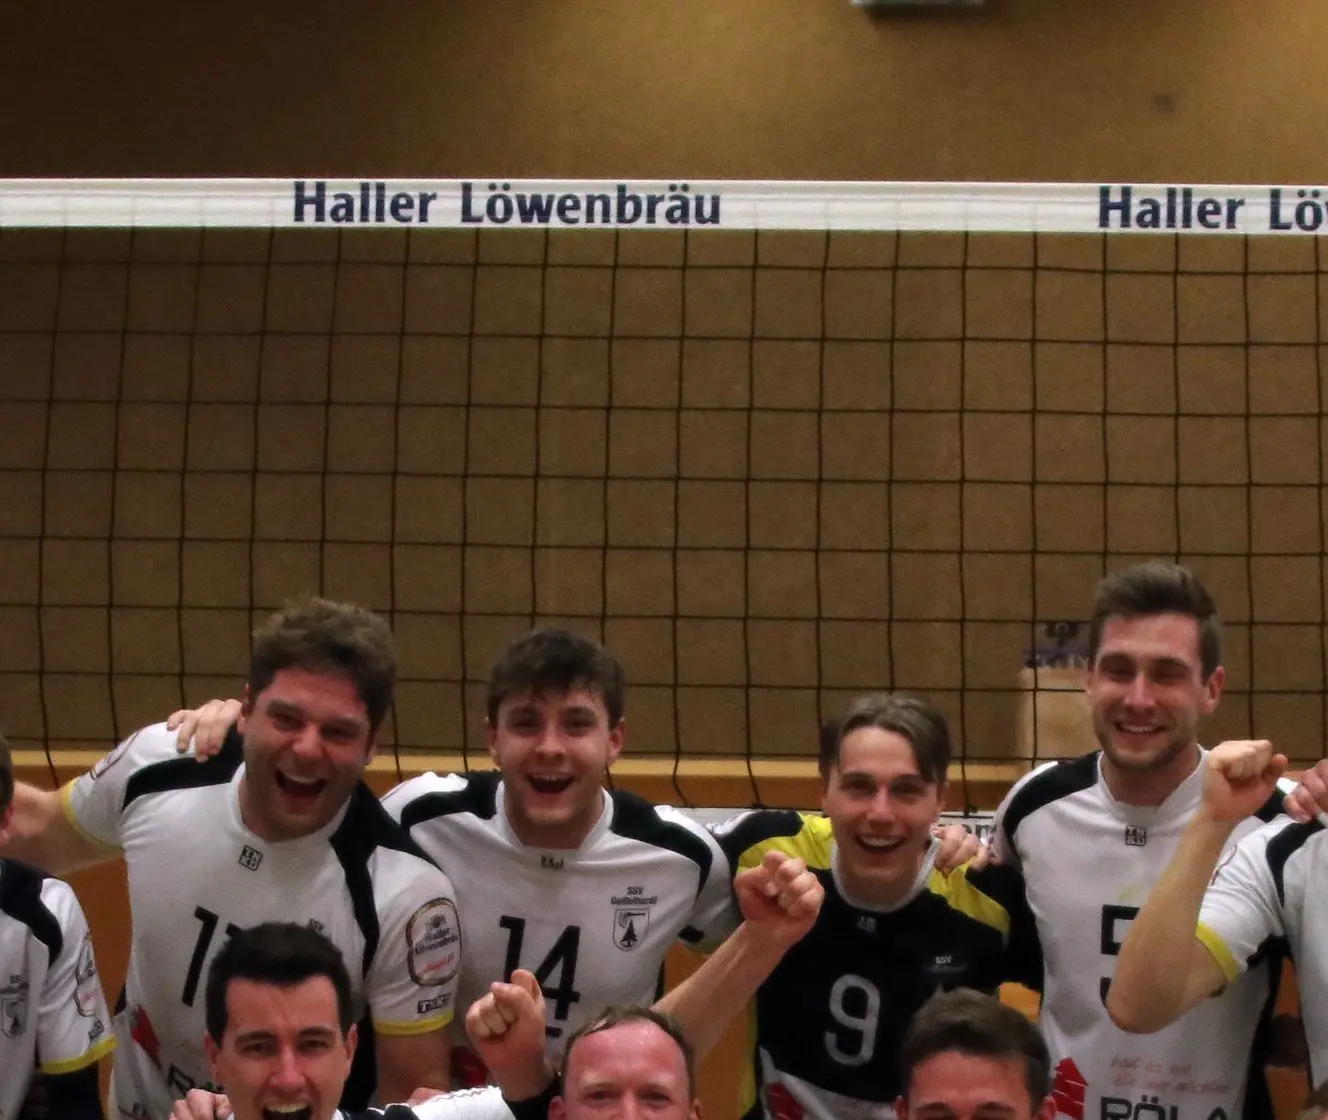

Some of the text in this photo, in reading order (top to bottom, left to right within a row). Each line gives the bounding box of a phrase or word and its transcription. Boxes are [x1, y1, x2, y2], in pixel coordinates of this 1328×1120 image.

[294, 181, 720, 224] Haller Löwenbräu
[1099, 185, 1244, 229] Haller
[500, 915, 580, 1020] 14
[825, 974, 880, 1066] 9
